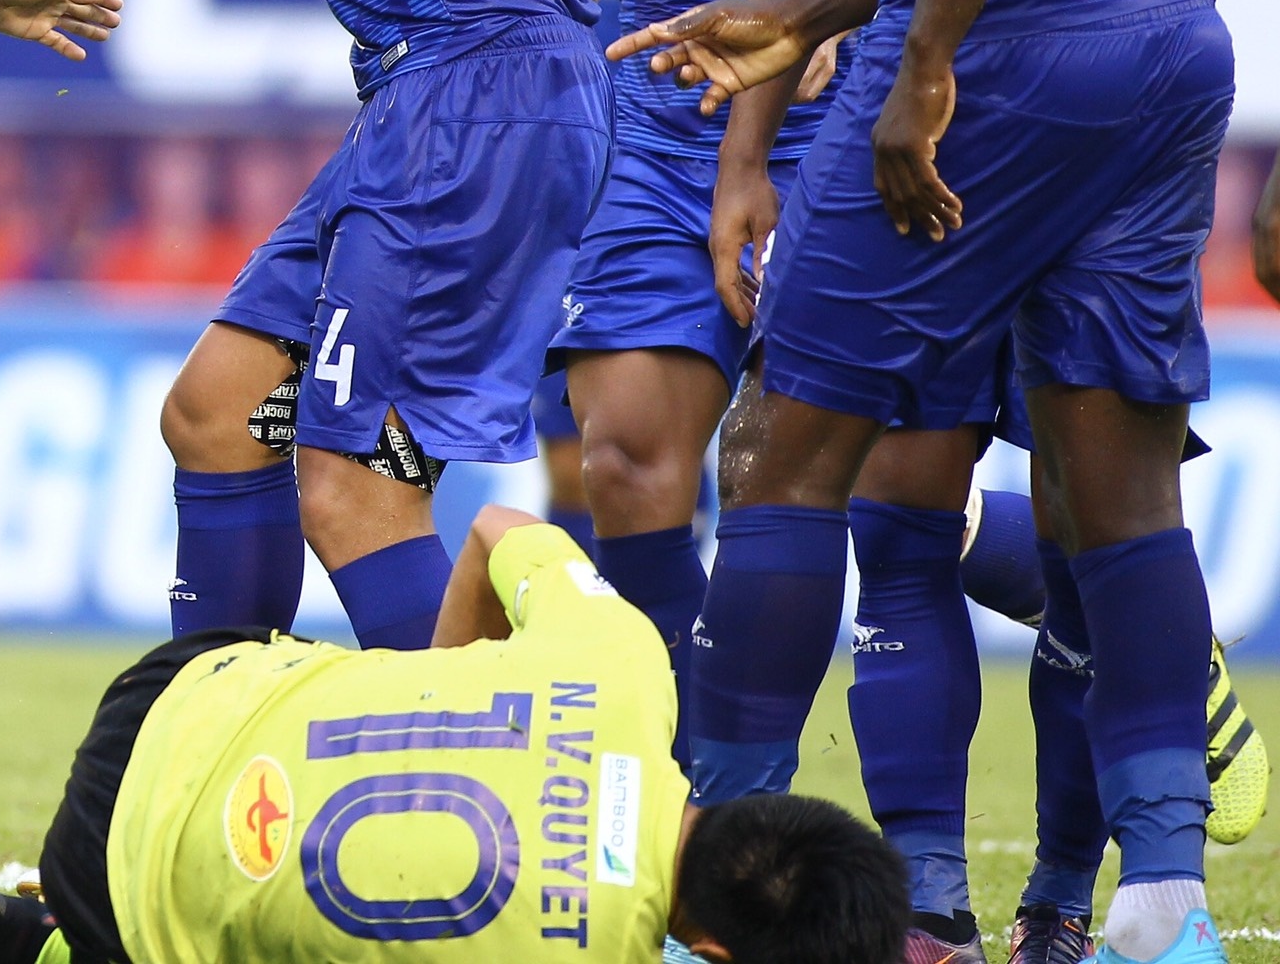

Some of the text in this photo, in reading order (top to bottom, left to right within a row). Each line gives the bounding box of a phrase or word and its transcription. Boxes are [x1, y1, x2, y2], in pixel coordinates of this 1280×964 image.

[313, 308, 356, 408] 4
[299, 691, 534, 943] 10
[537, 681, 597, 949] N.V.QUYET
